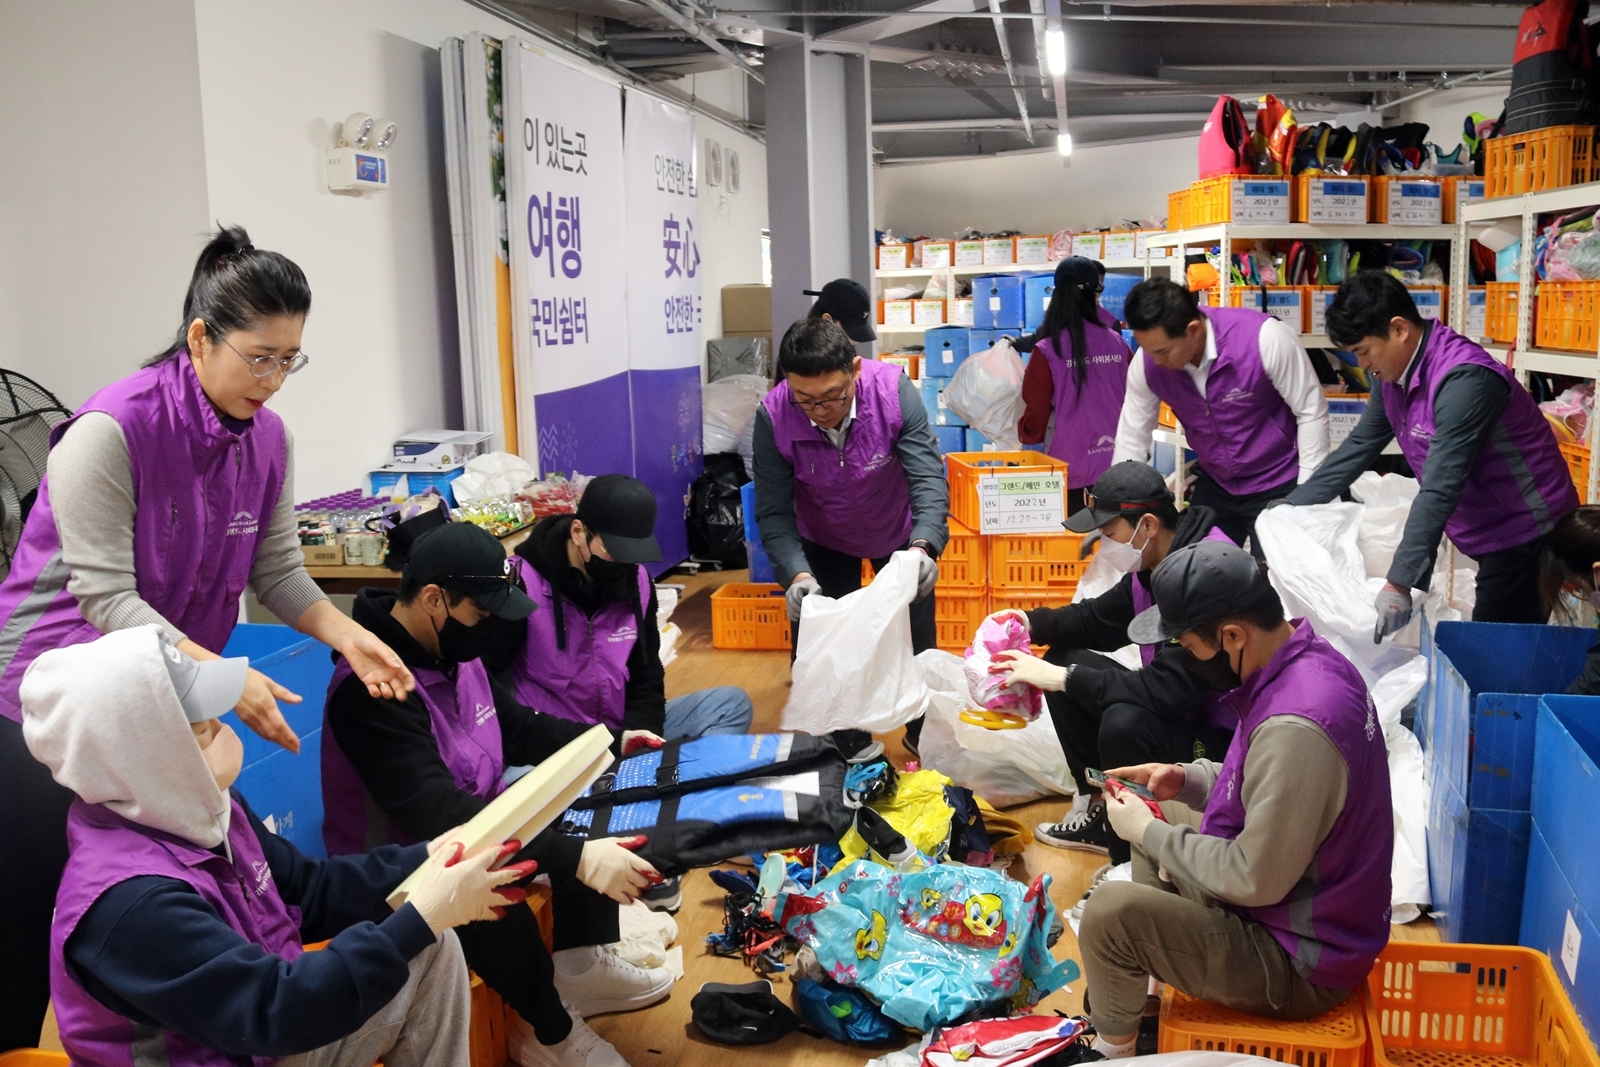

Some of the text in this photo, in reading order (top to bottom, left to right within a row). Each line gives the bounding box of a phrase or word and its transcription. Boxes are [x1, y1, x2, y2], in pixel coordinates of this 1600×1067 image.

[523, 117, 588, 176] 이 있는곳
[655, 154, 685, 195] 안전한
[527, 191, 582, 279] 여행
[663, 213, 701, 279] 安心
[664, 294, 694, 334] 안전한
